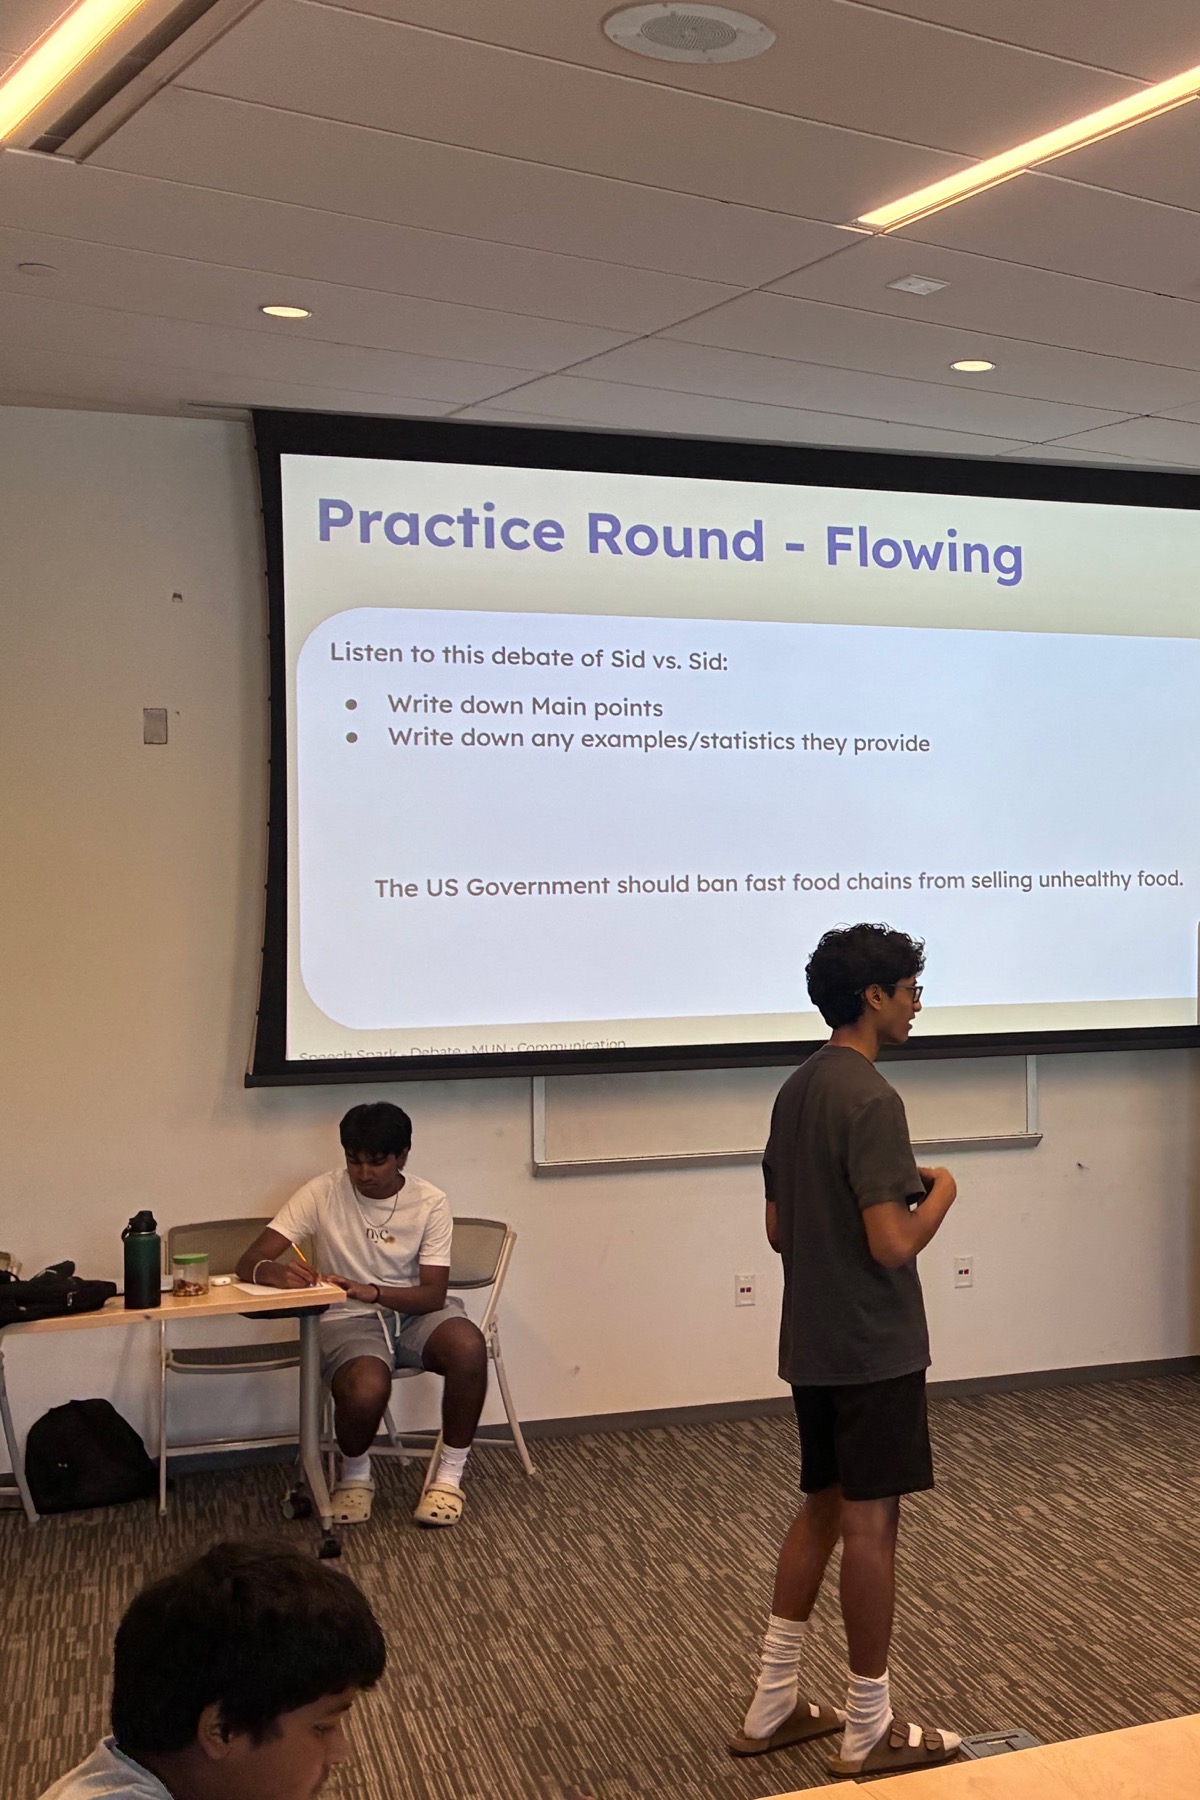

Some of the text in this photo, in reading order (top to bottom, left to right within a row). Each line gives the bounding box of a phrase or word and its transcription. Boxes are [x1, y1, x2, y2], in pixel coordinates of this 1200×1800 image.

[318, 497, 565, 553] Practice
[588, 512, 764, 562] Round
[826, 525, 1023, 587] Flowing
[331, 640, 728, 672] Listen to this debate of Sid vs. Sid:
[387, 693, 664, 721] Write down Main points
[387, 726, 931, 756] Write down any examples/statistics they provide
[374, 869, 1184, 898] The US Government should ban fast food chains from selling unhealthy food.
[517, 1039, 626, 1052] Communication
